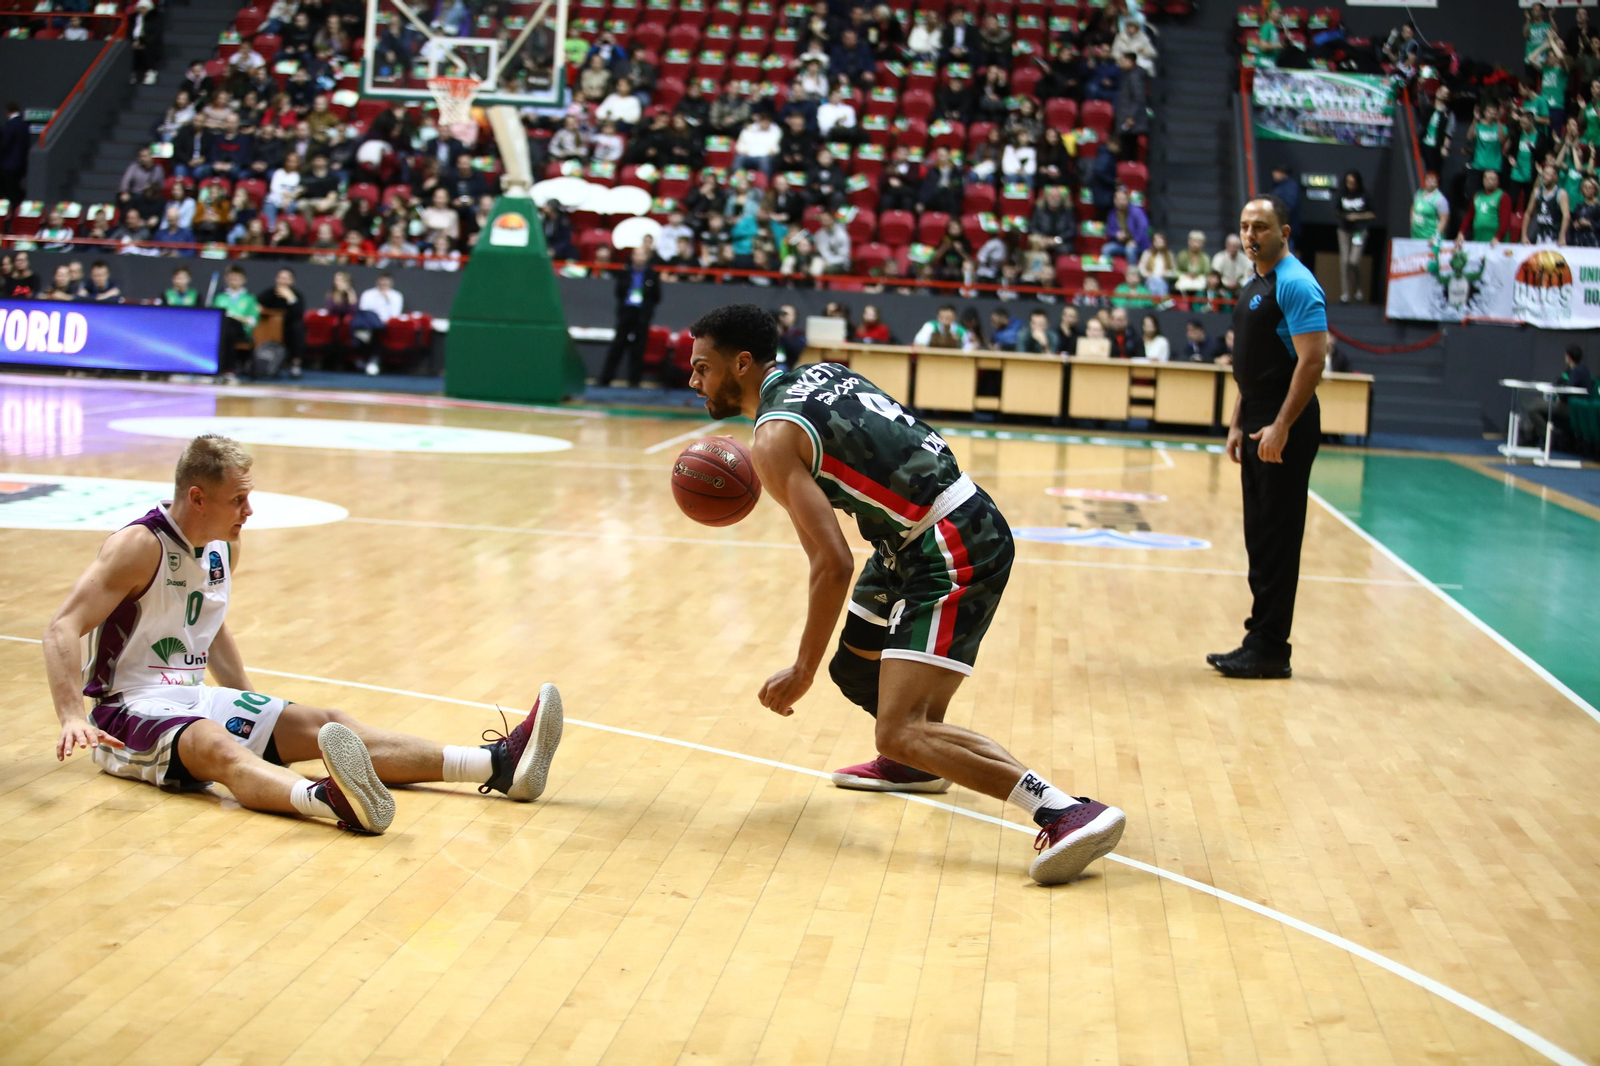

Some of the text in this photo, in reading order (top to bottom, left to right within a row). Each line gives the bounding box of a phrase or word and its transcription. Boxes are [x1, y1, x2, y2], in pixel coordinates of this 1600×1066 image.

[1579, 266, 1600, 283] UNI
[783, 363, 842, 403] LOCKETT
[887, 599, 906, 634] 4
[184, 652, 208, 665] Uni
[233, 692, 271, 714] 10
[1019, 773, 1050, 799] PEAK
